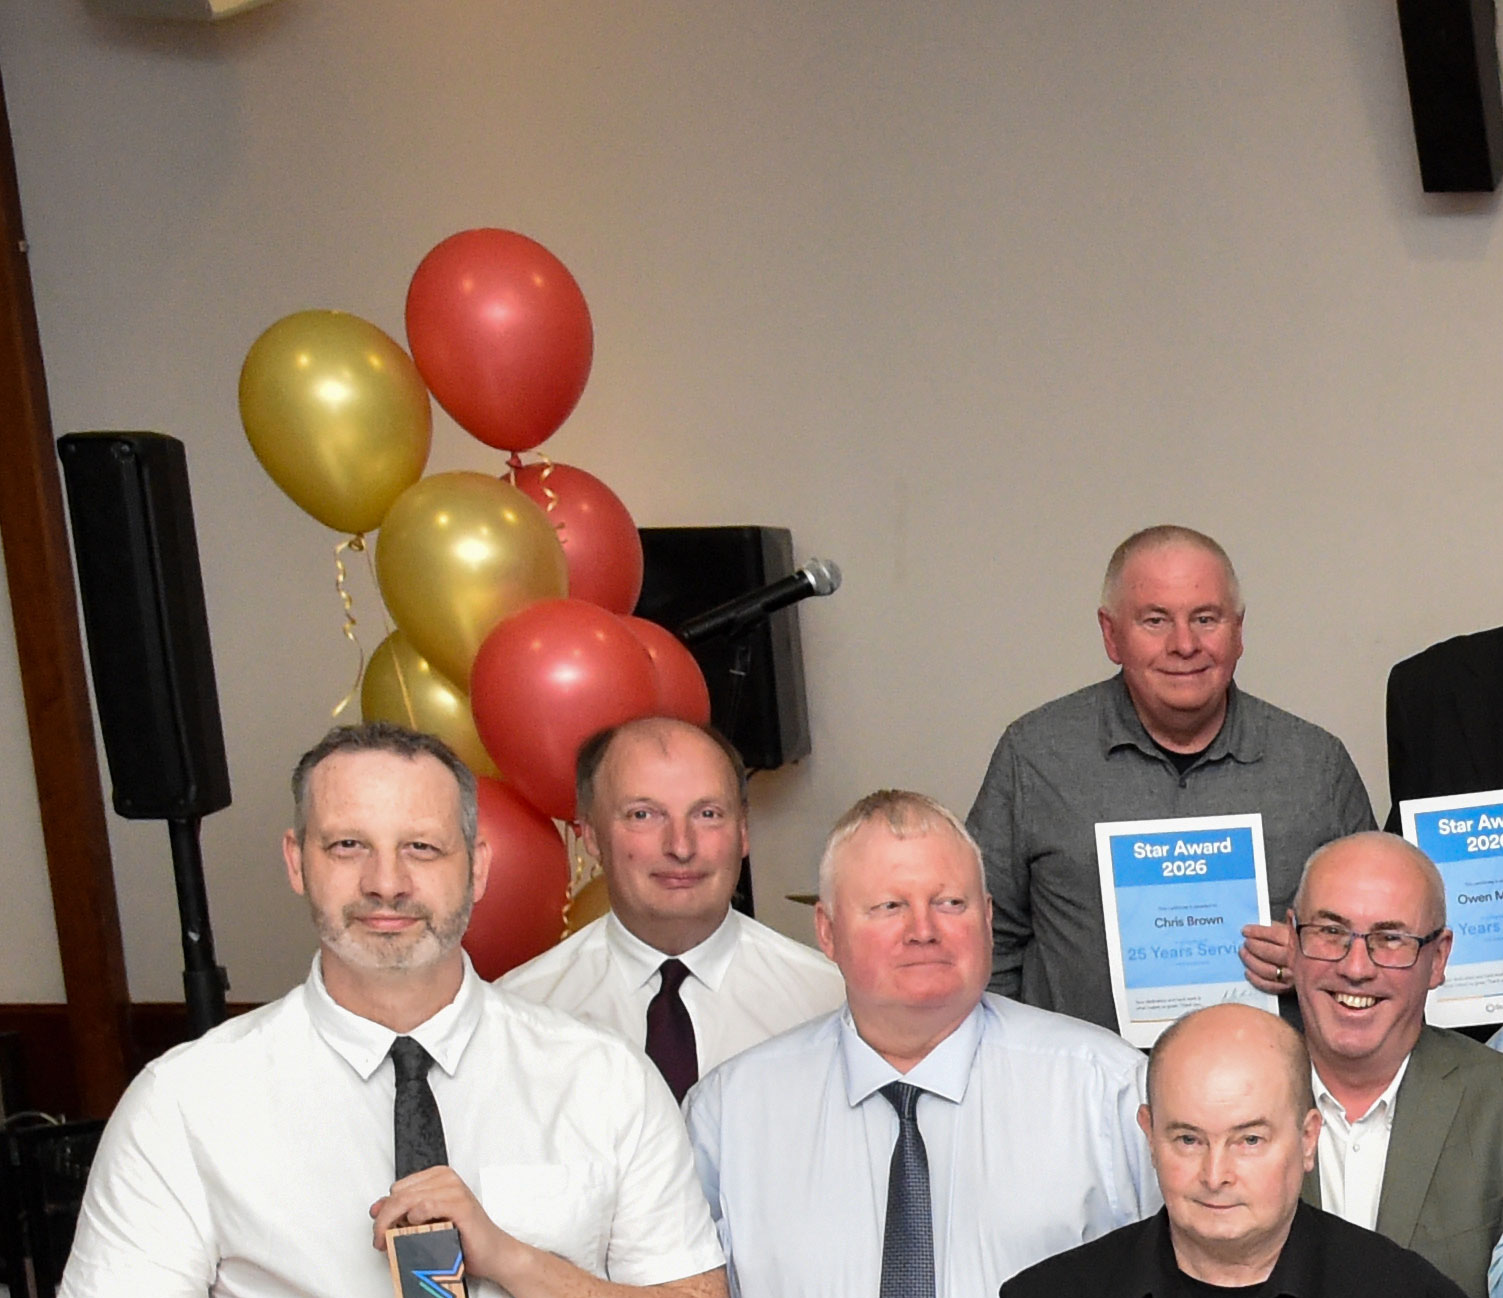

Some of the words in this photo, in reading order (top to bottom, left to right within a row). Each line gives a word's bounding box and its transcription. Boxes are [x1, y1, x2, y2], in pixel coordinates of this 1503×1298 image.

[1439, 818, 1473, 835] Star
[1134, 842, 1169, 858] Star
[1174, 837, 1231, 856] Award
[1162, 860, 1207, 876] 2026
[1458, 893, 1492, 905] Owen
[1154, 916, 1184, 928] Chris
[1187, 915, 1223, 926] Brown
[1459, 922, 1500, 936] Years
[1128, 947, 1146, 960] 25
[1151, 944, 1192, 959] Years
[1198, 941, 1240, 956] Servi
